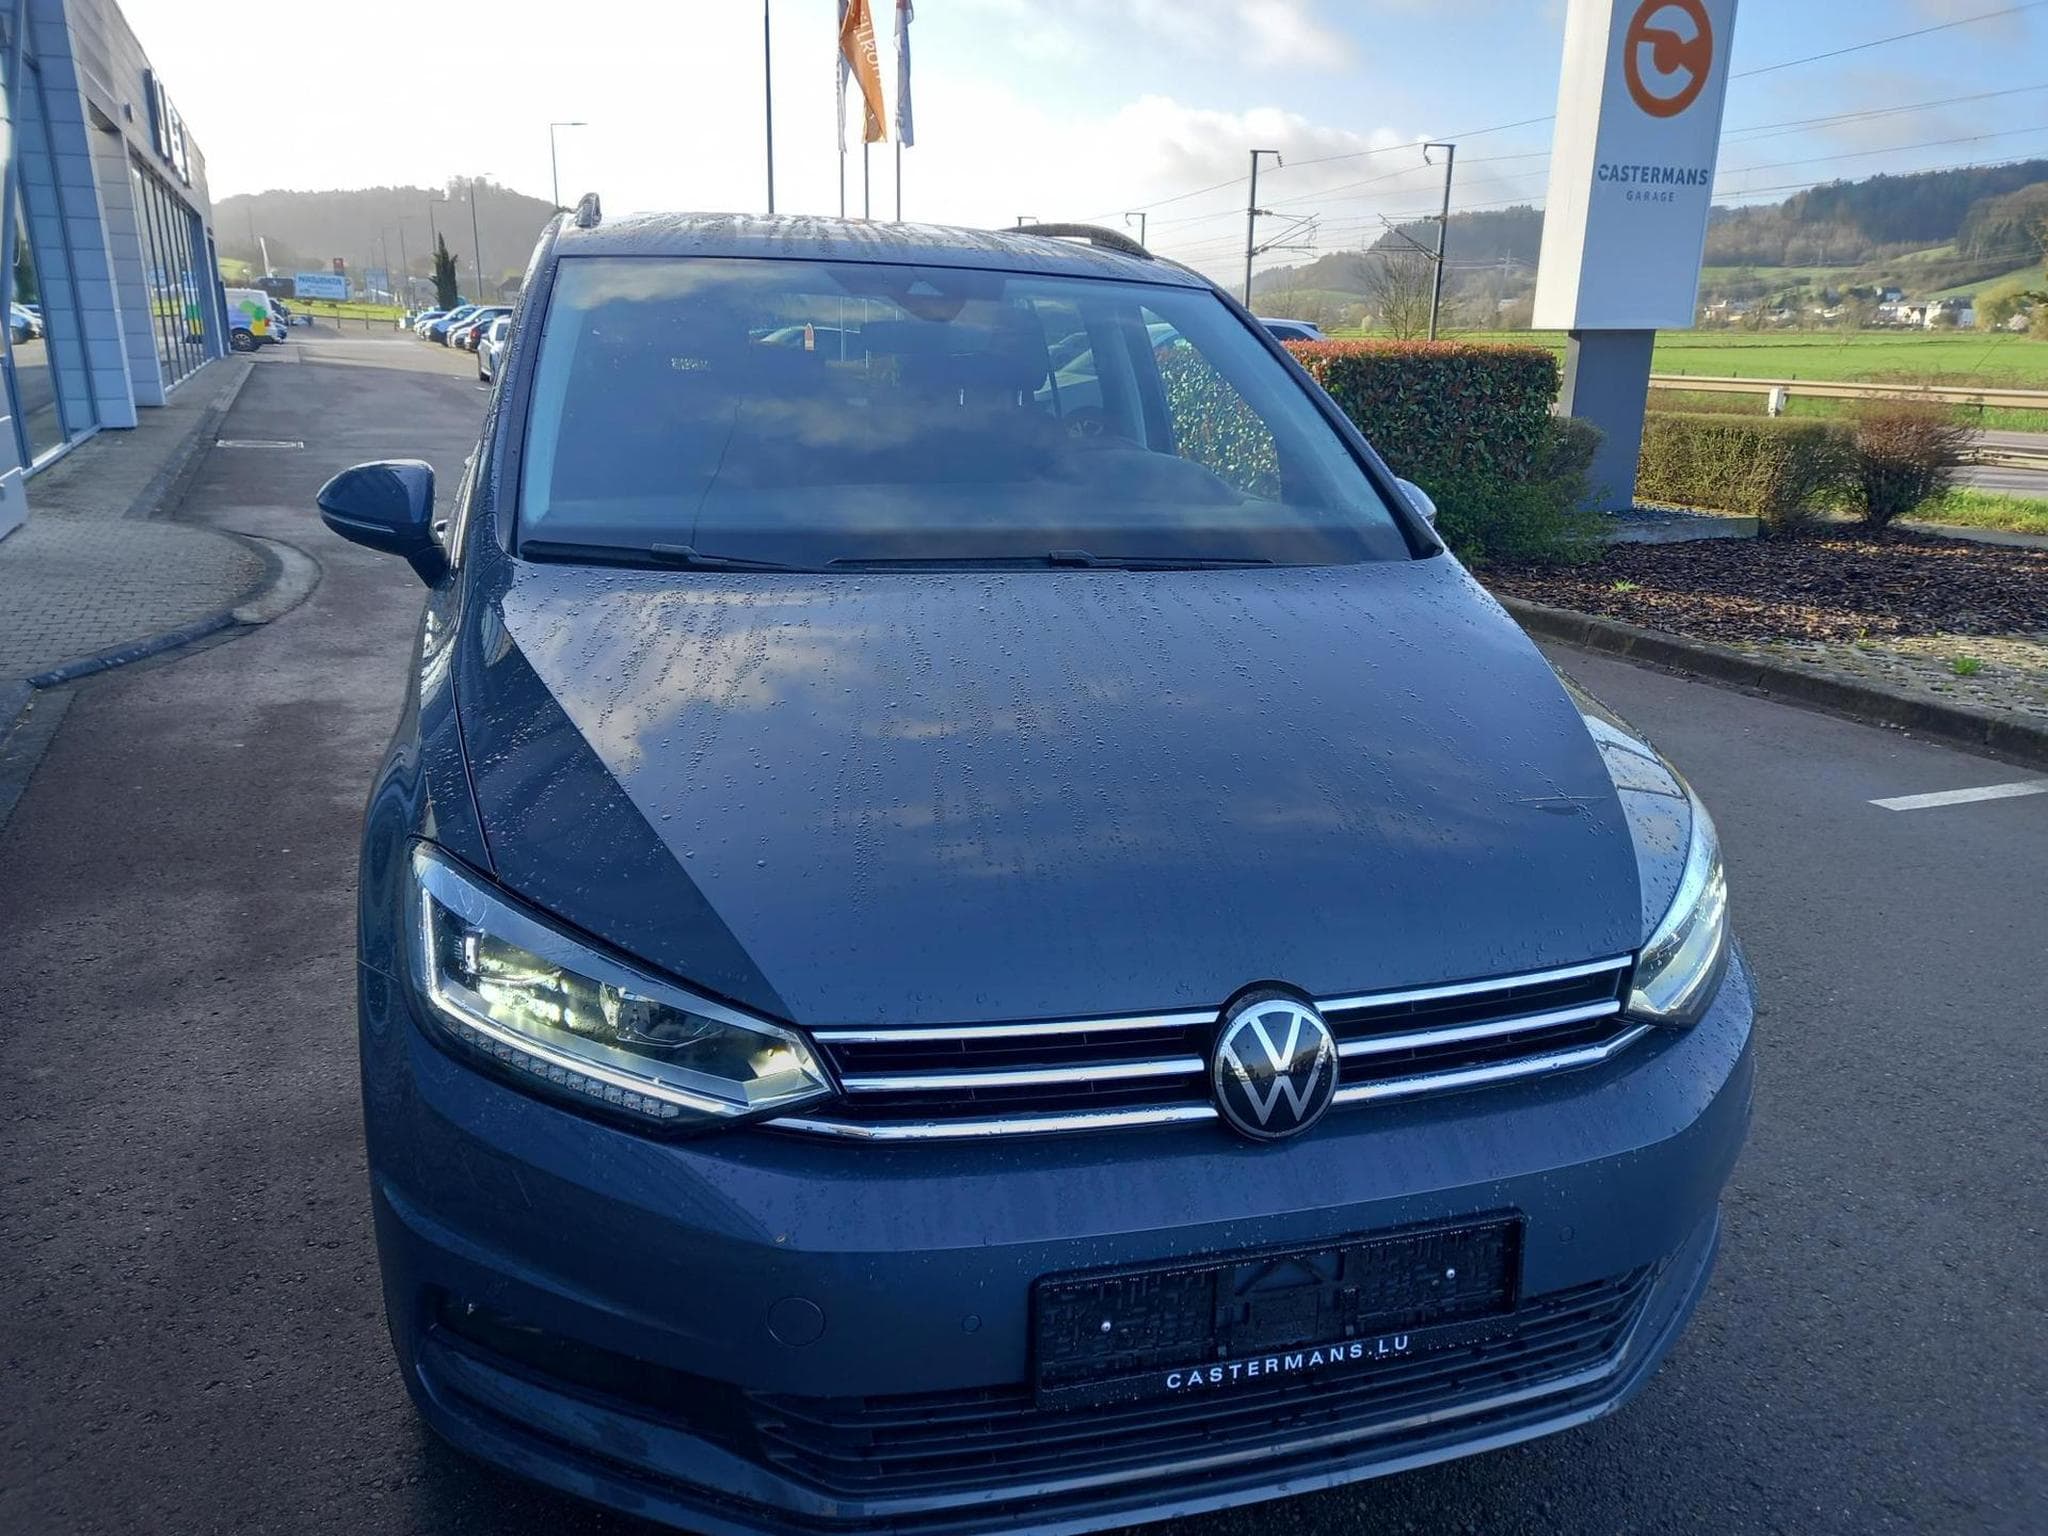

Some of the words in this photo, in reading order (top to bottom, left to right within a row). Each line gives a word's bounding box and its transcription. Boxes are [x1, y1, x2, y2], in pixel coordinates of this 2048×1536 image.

[1598, 164, 1709, 186] CASTERMANS
[1626, 190, 1675, 202] GARAGE
[1166, 1335, 1409, 1389] CASTERMANS.LU
